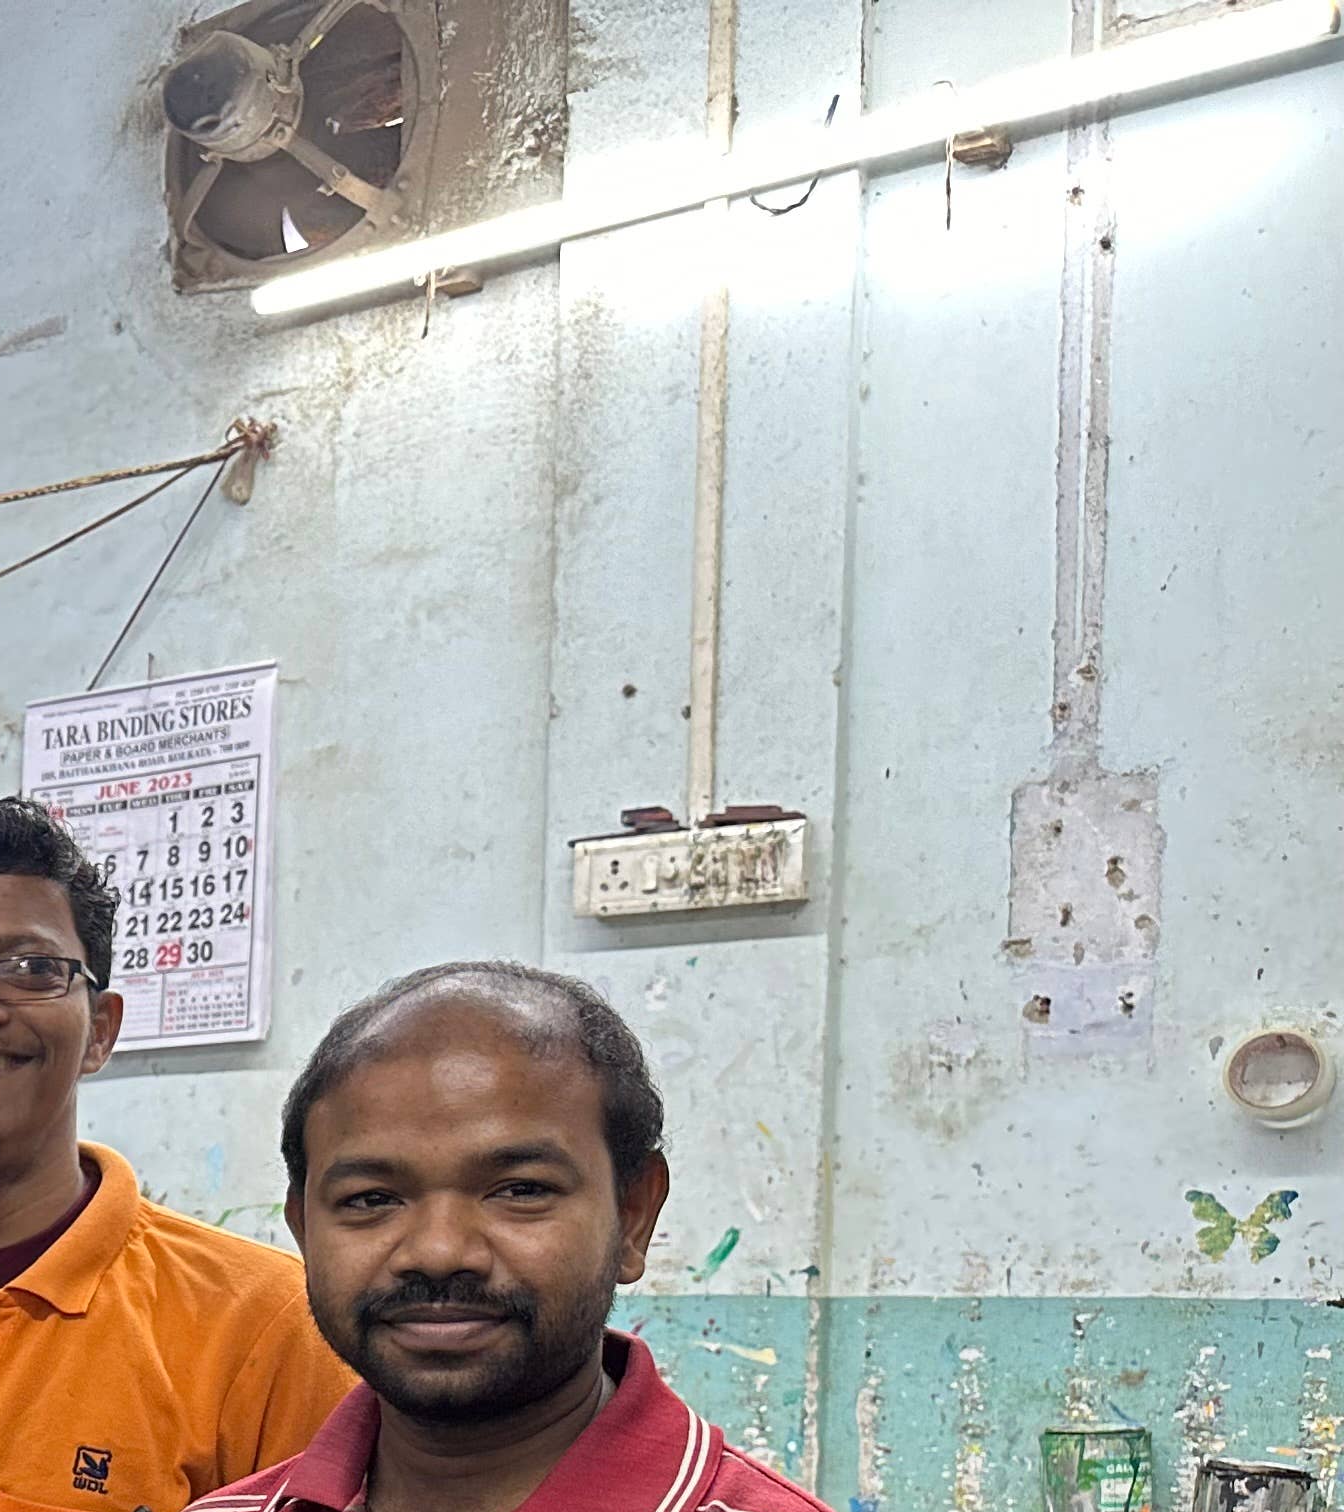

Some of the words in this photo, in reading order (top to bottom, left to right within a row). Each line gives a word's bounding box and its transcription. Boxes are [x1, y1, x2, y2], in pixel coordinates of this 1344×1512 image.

[42, 724, 92, 750] TARA
[97, 709, 175, 743] BINDING
[179, 695, 252, 726] STORES
[62, 748, 101, 765] PAPER
[104, 747, 112, 760] &
[116, 740, 155, 759] BOARD
[159, 727, 228, 750] MERCHANTS
[96, 780, 141, 800] JUNE
[149, 772, 193, 792] 2023
[169, 811, 178, 834] 1
[201, 806, 215, 828] 2
[230, 802, 244, 824] 3
[137, 850, 149, 872] 7
[168, 845, 180, 867] 8
[198, 841, 211, 863] 9
[223, 835, 248, 859] 10
[128, 881, 152, 903] 14
[159, 878, 184, 900] 15
[190, 875, 216, 897] 16
[223, 870, 248, 893] 17
[126, 915, 149, 937] 21
[156, 911, 183, 934] 22
[188, 907, 214, 930] 23
[220, 902, 246, 926] 24
[123, 948, 149, 970] 28
[156, 944, 182, 967] 29
[187, 940, 213, 964] 30
